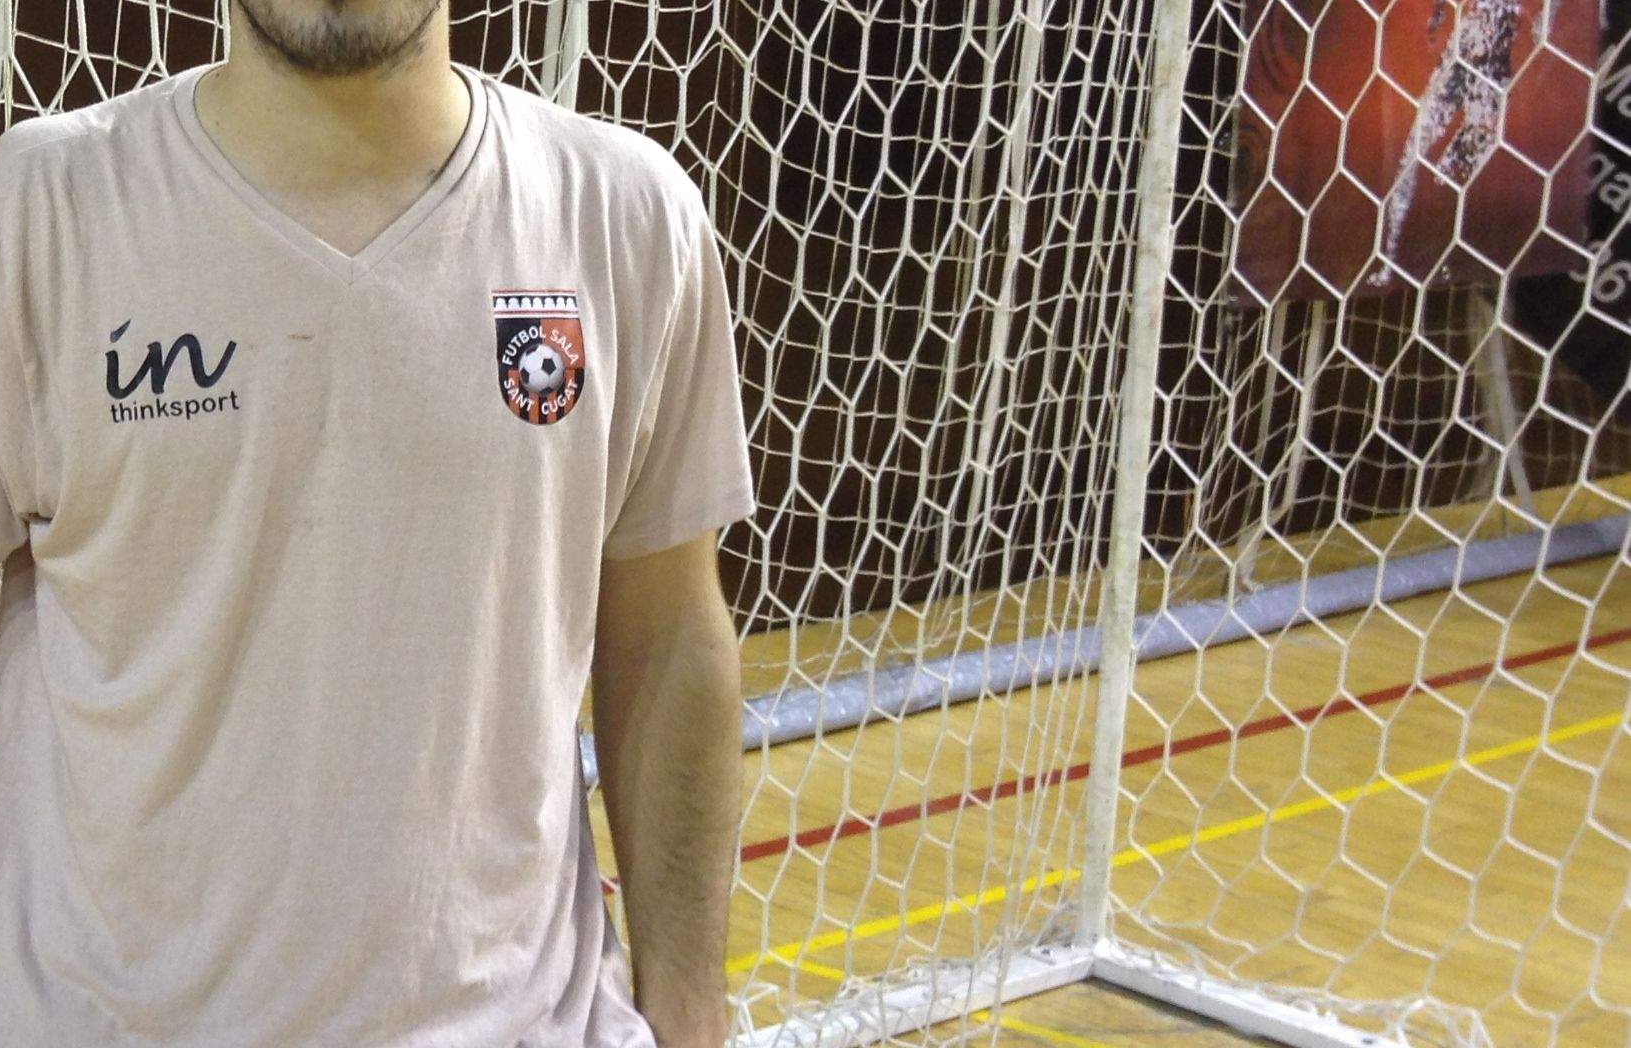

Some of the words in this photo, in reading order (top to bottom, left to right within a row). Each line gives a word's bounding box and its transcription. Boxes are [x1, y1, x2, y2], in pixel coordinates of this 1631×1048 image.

[502, 325, 546, 366] FUTBOL
[550, 328, 579, 365] SALA
[110, 390, 240, 423] thinksport
[503, 377, 536, 412] SANT
[541, 378, 578, 415] CUGAT
